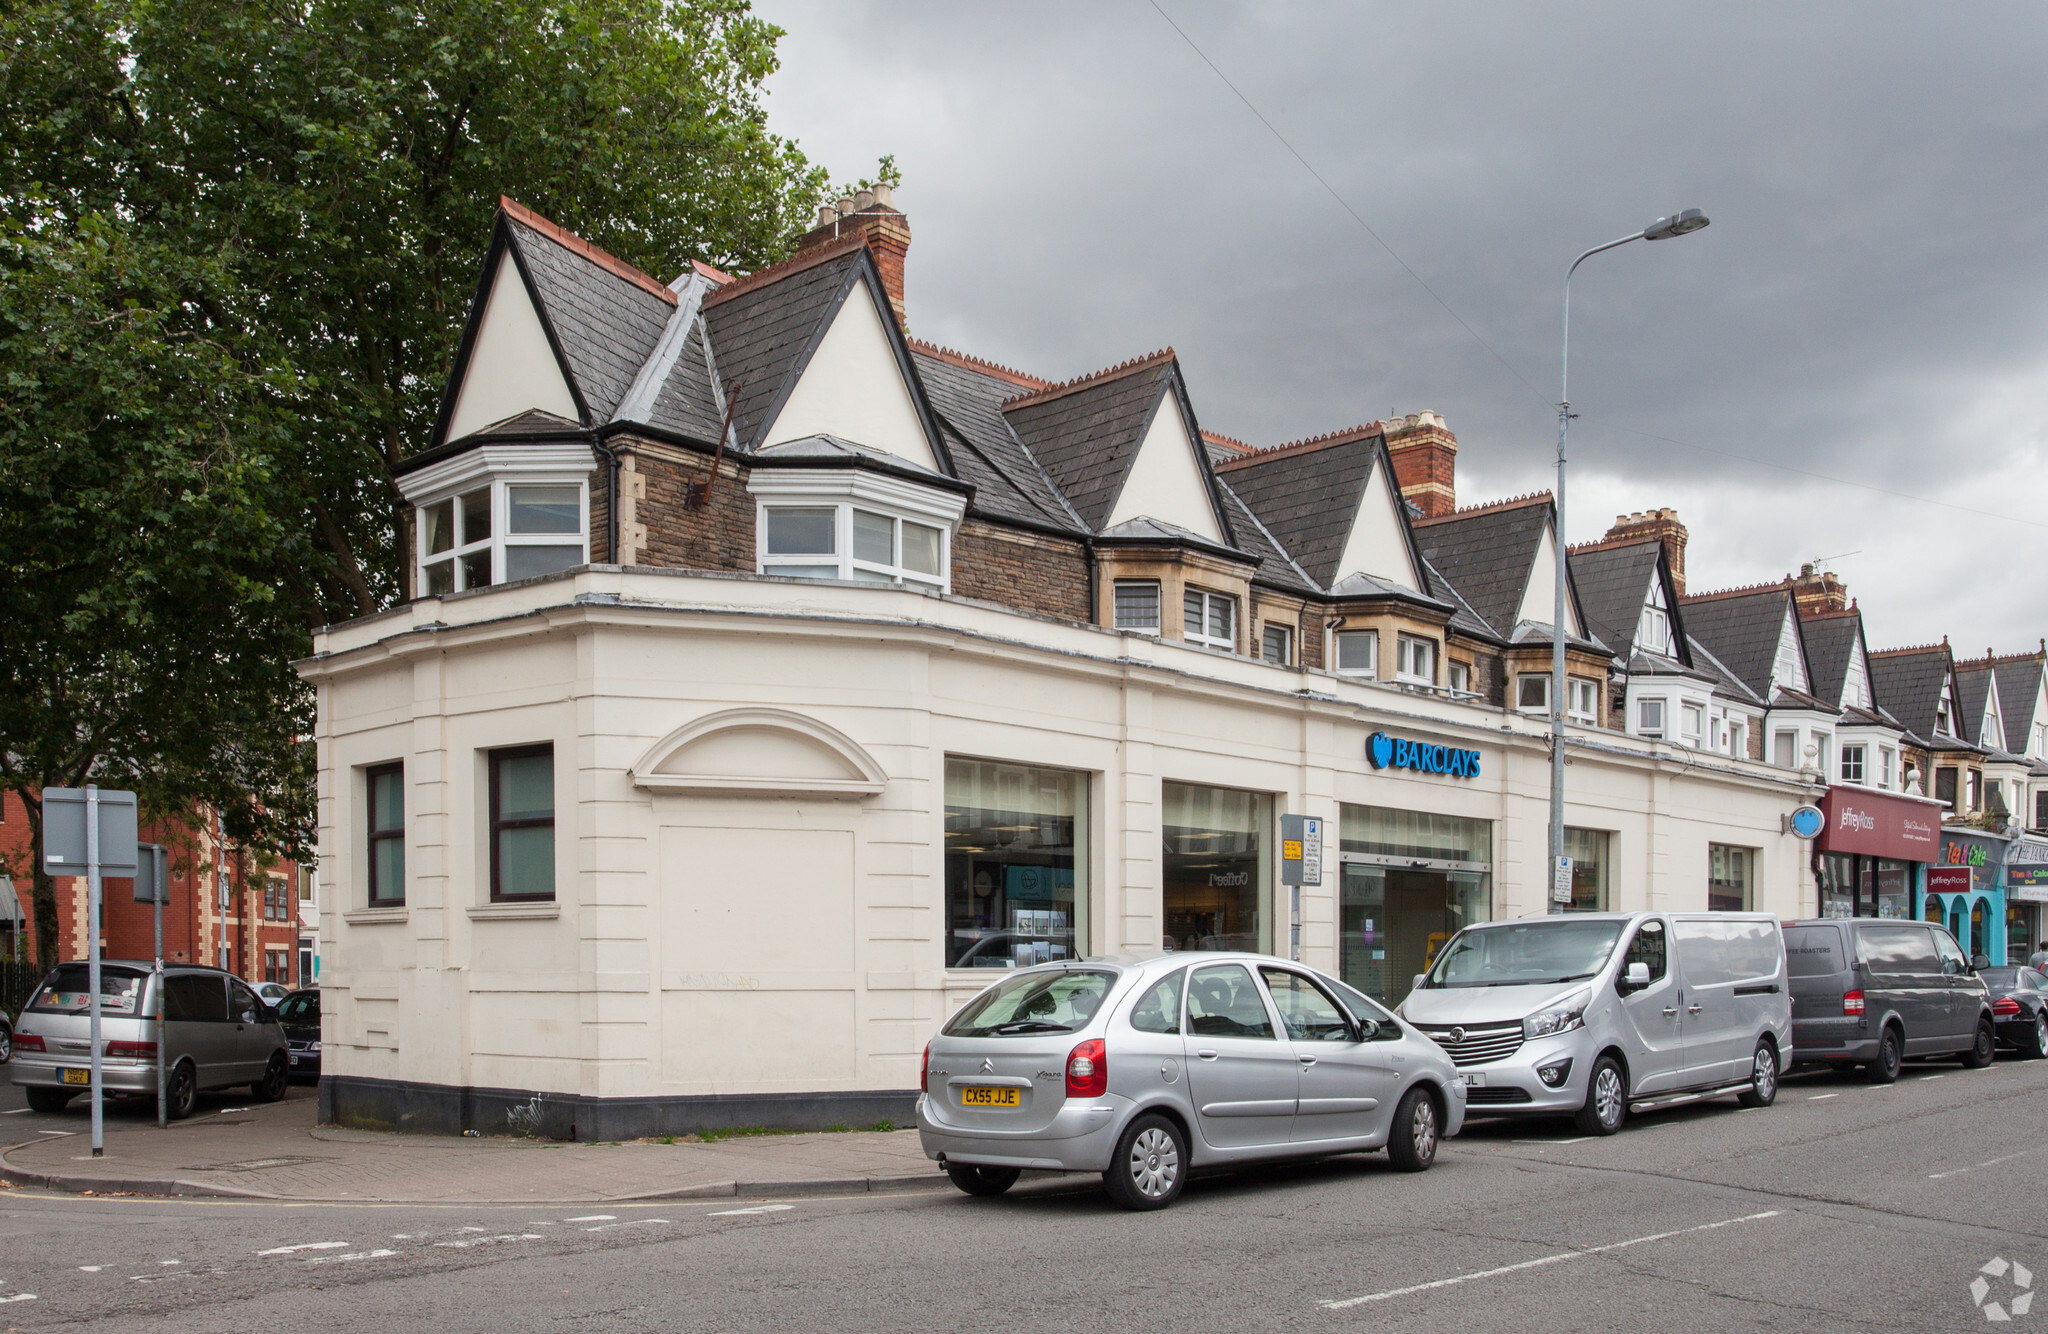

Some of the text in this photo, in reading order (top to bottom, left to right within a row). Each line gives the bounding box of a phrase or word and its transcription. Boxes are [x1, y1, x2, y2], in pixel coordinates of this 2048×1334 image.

[1395, 738, 1481, 778] BARCLAYS
[1947, 841, 1987, 867] Tea & Cake
[966, 1089, 1015, 1104] CX55 JJE
